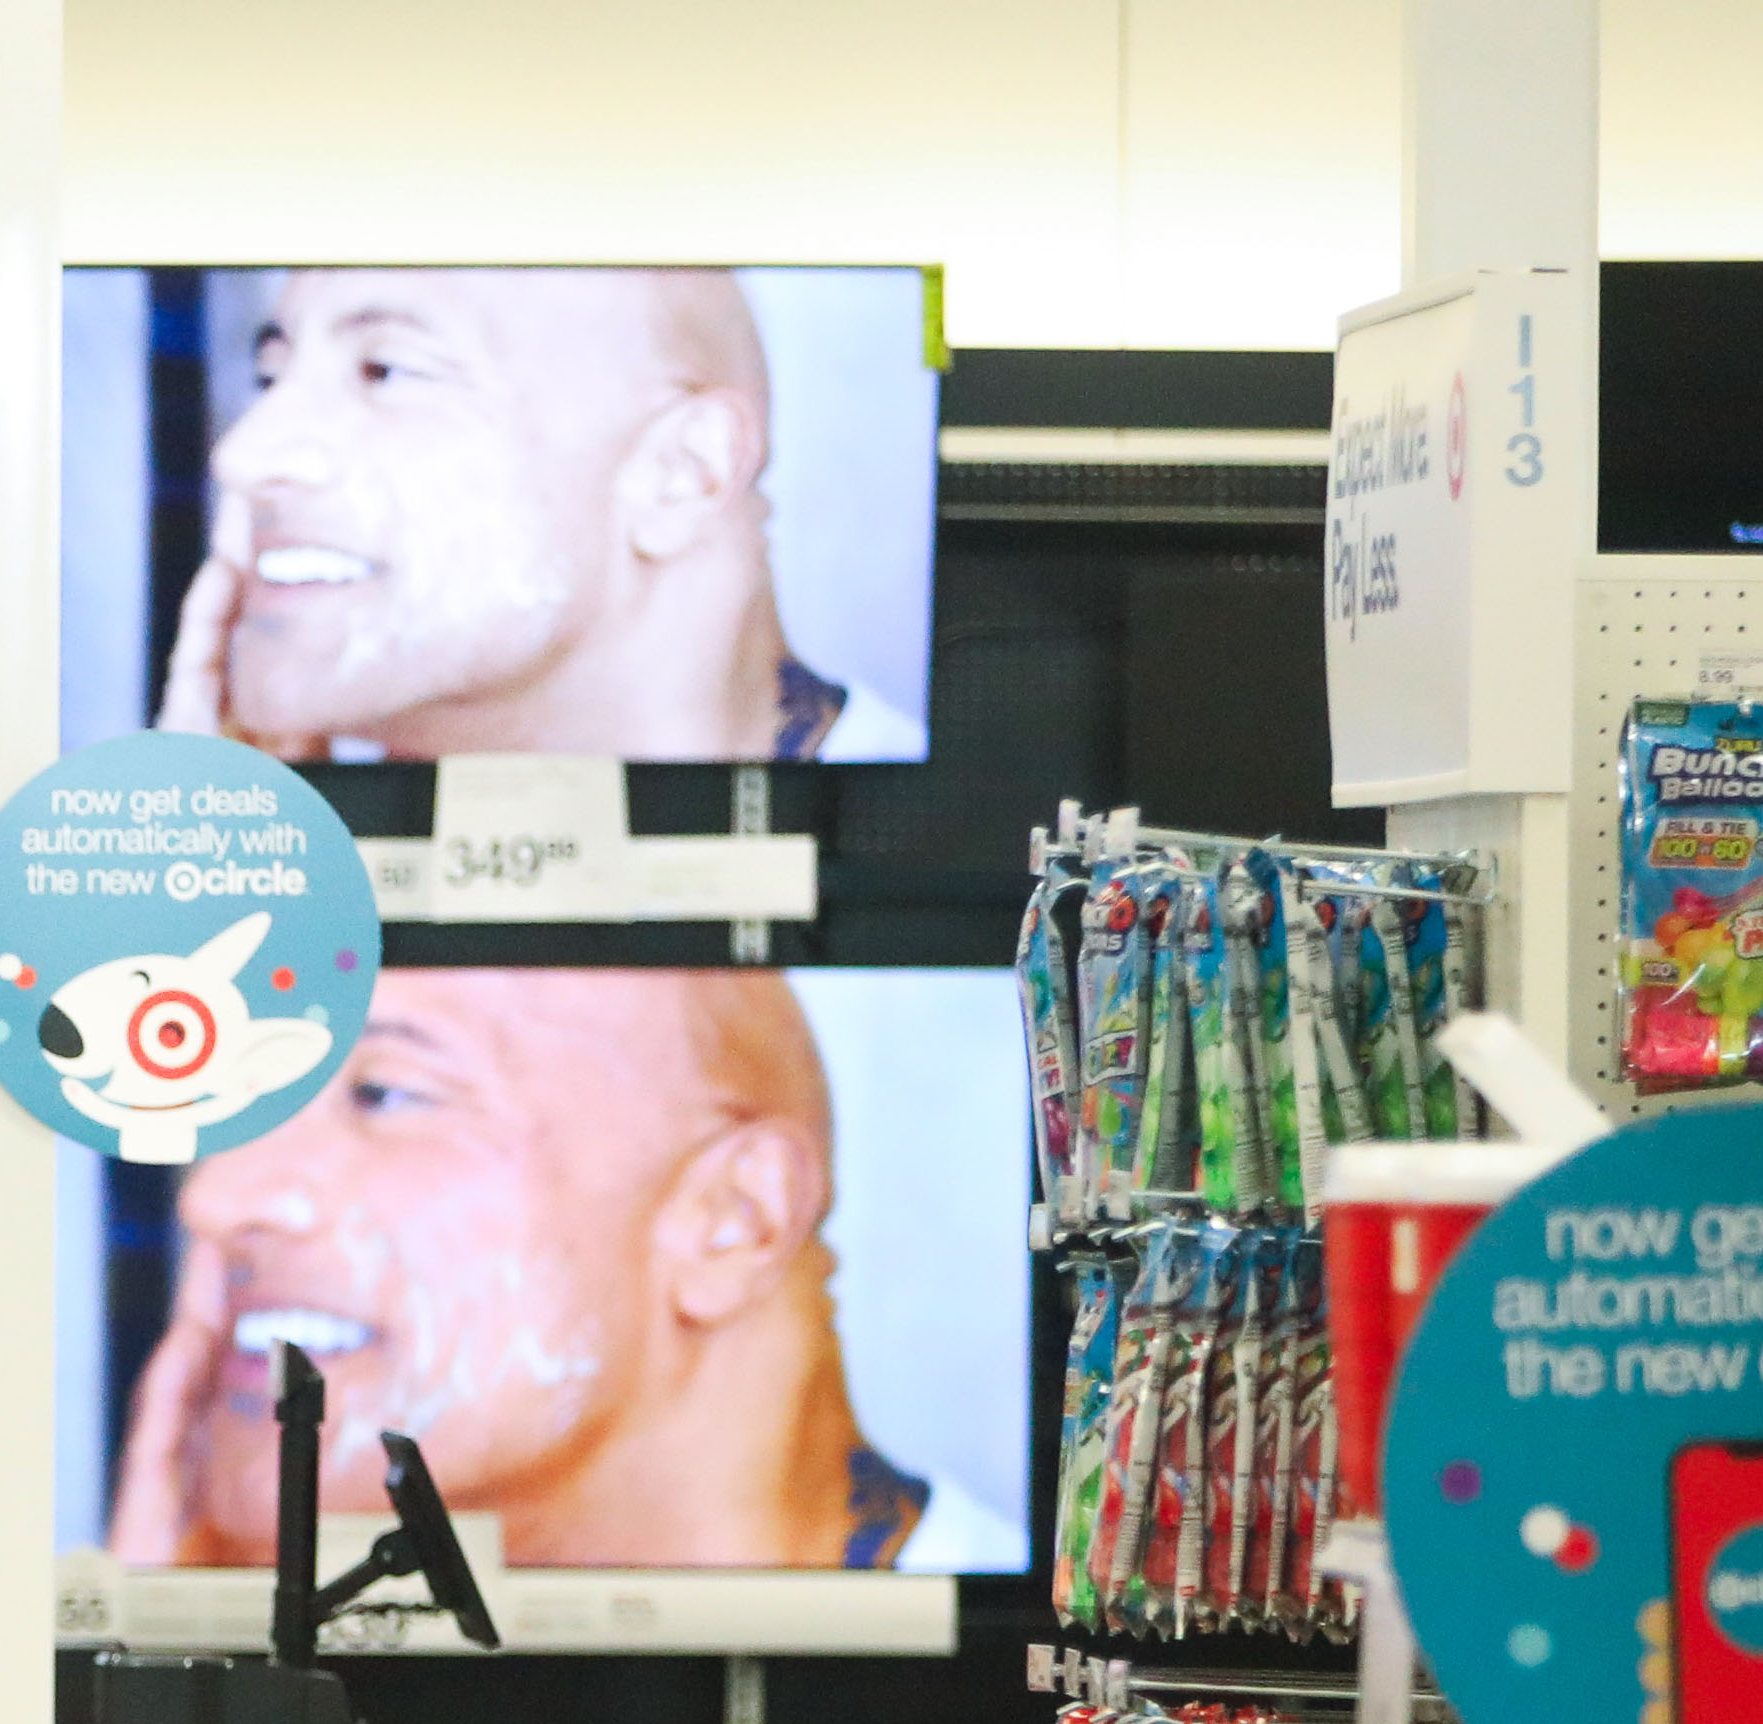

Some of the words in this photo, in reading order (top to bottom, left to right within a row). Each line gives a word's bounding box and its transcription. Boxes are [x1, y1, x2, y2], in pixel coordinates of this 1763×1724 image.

[1652, 745, 1763, 778] Bunc
[50, 788, 122, 816] now
[128, 784, 183, 824] get
[189, 782, 279, 817] deals
[1660, 776, 1763, 801] Balloo
[21, 821, 233, 862] automatically
[237, 822, 308, 856] with
[25, 862, 80, 896] the
[85, 868, 157, 896] new
[201, 858, 308, 897] circle
[1544, 1207, 1682, 1262] now
[1689, 1204, 1763, 1270] ge
[1492, 1265, 1763, 1331] automati
[1501, 1337, 1607, 1400] the
[1614, 1338, 1752, 1399] new
